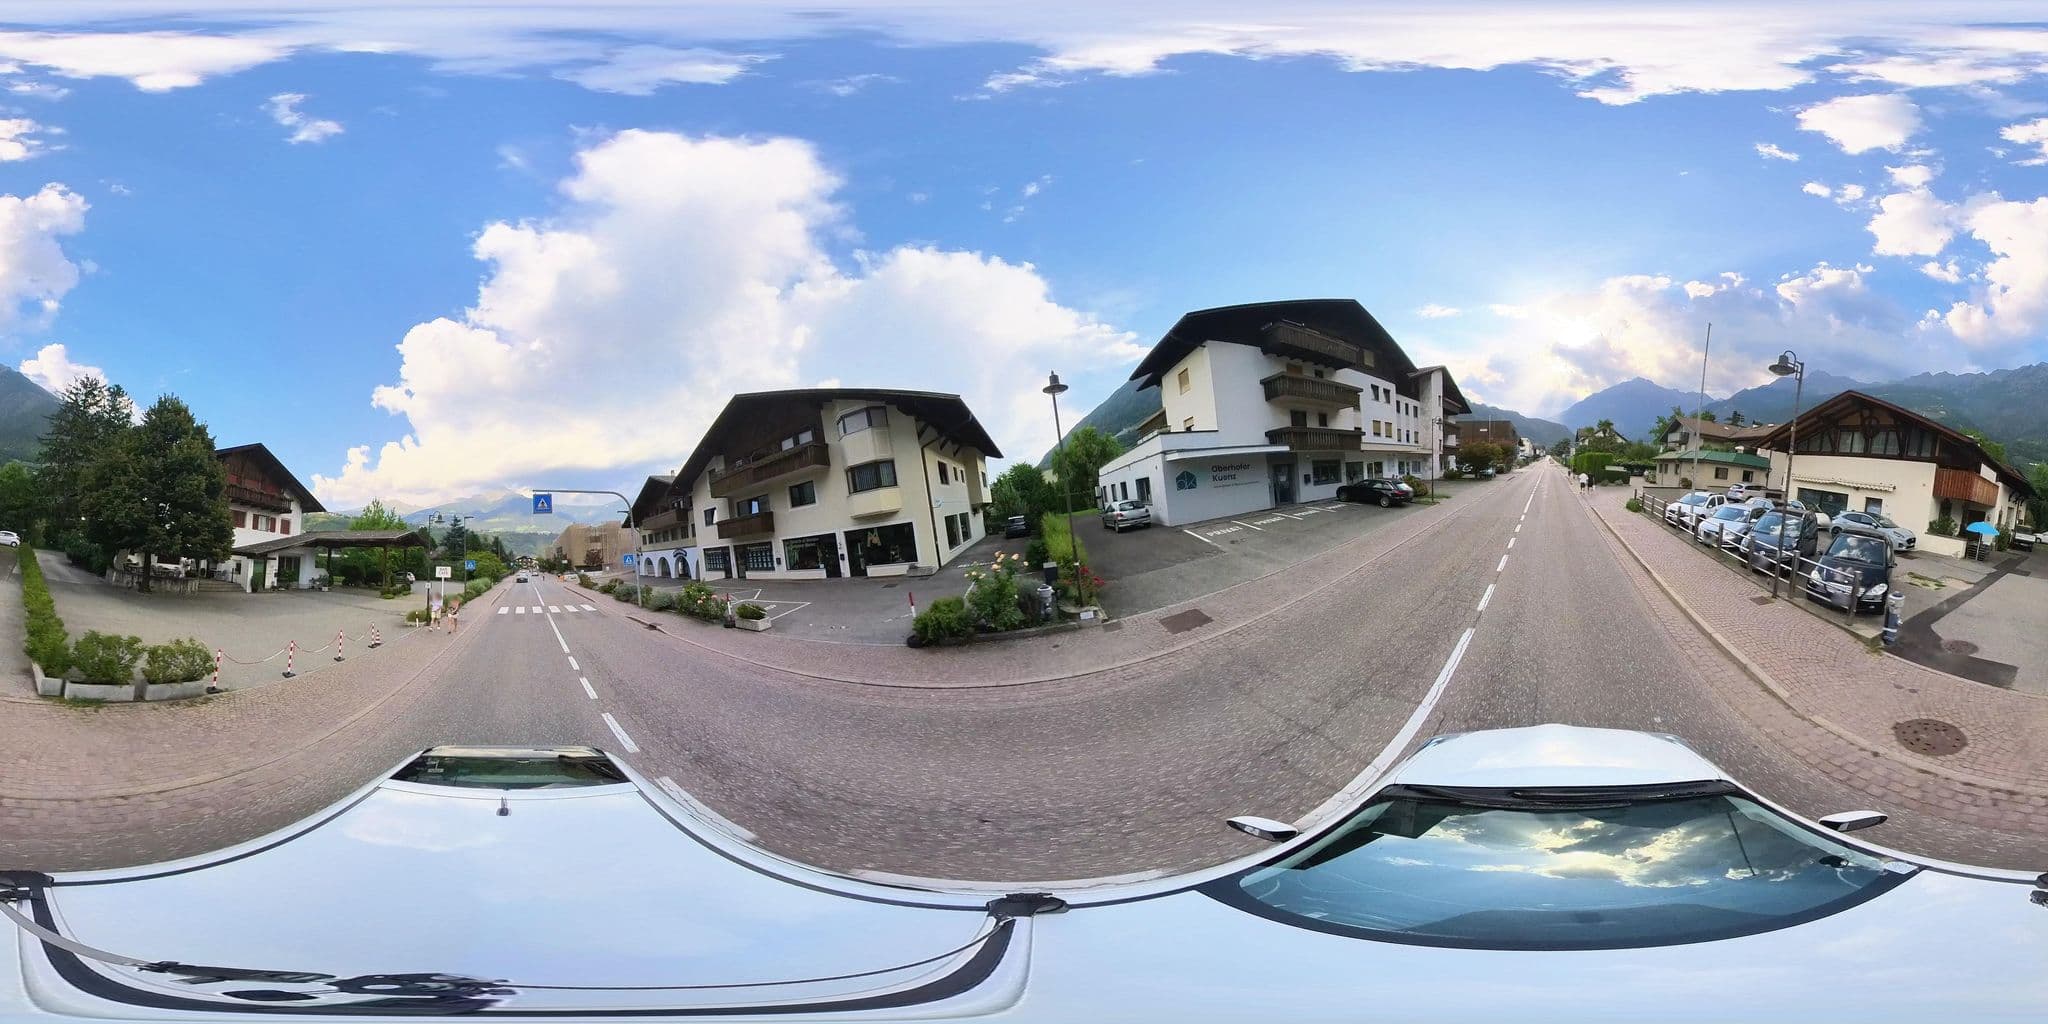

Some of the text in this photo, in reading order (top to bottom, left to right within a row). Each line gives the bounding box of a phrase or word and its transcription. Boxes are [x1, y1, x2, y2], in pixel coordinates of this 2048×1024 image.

[1211, 463, 1251, 473] Oberhofer
[1212, 473, 1237, 482] Kuenz
[1206, 526, 1243, 537] PRIVAT
